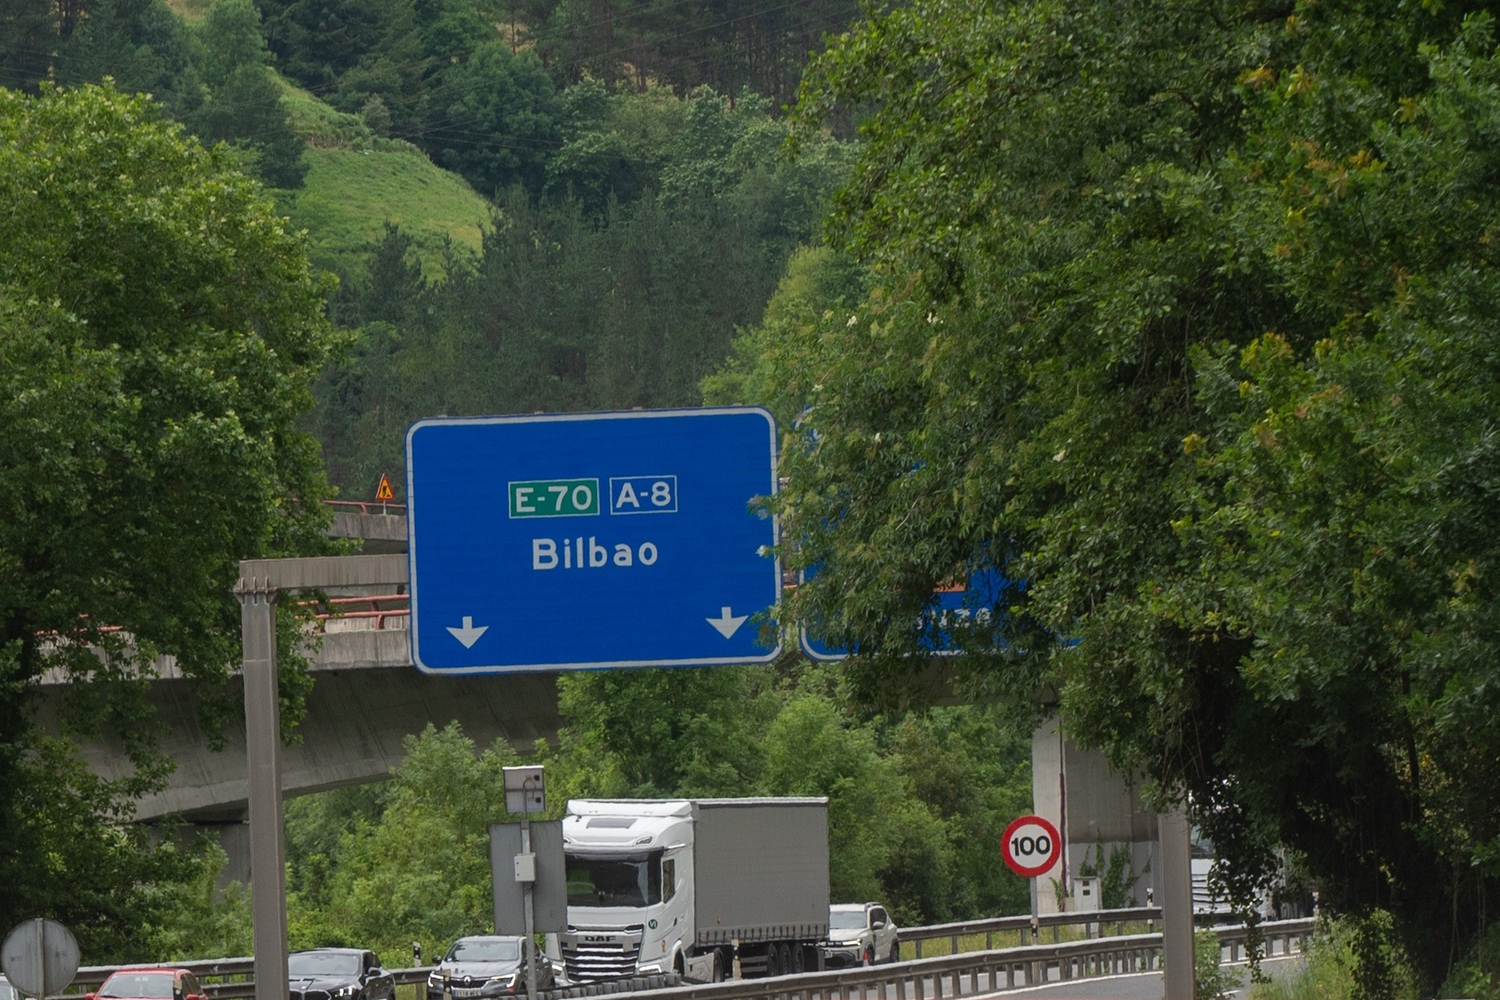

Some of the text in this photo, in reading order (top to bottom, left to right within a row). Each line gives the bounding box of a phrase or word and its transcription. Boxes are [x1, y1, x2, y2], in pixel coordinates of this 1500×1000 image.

[515, 484, 593, 513] E-70
[615, 481, 672, 509] A-8
[532, 536, 658, 570] Bilbao
[1011, 835, 1051, 857] 100
